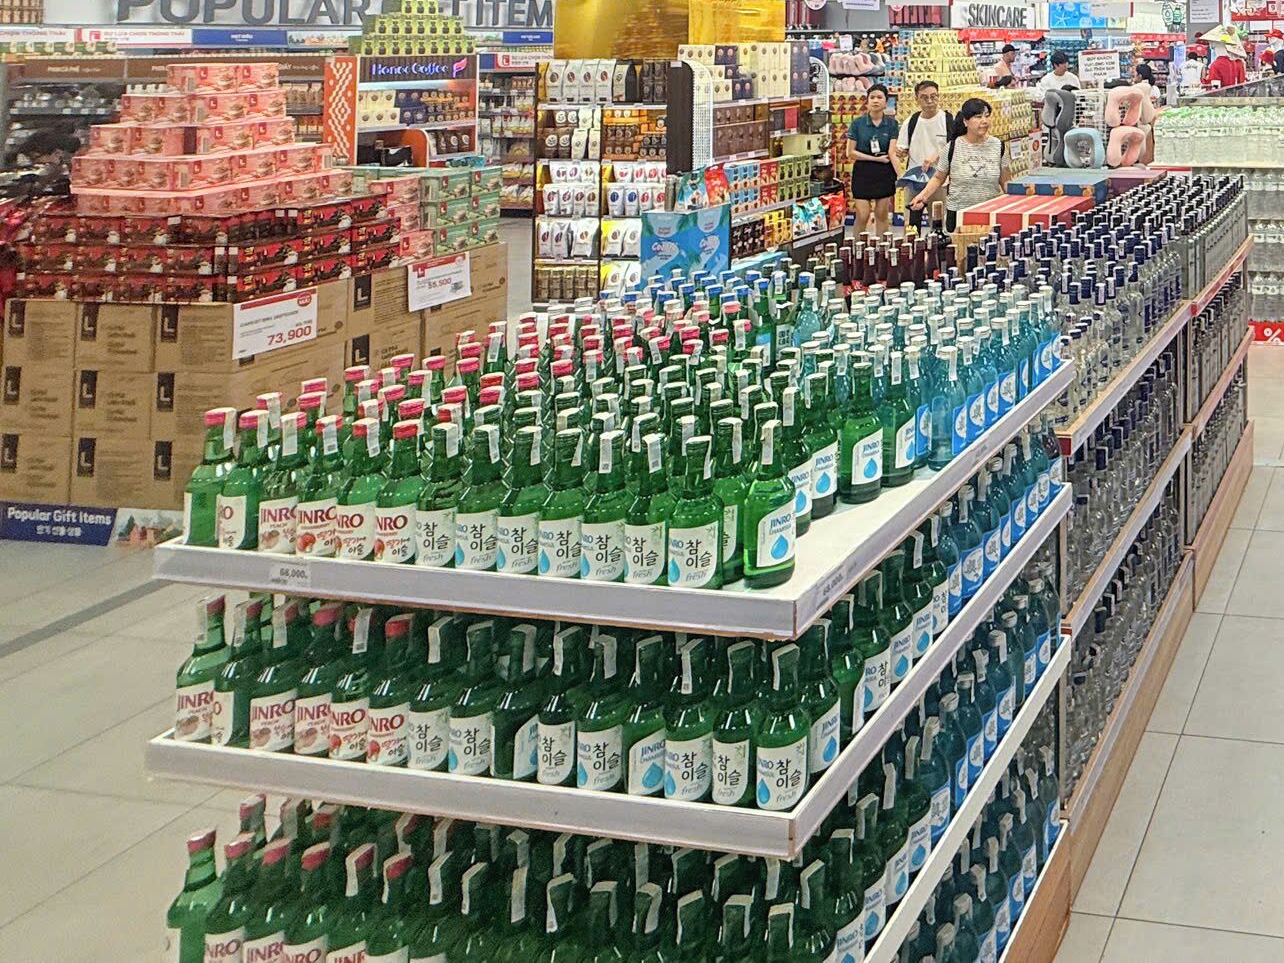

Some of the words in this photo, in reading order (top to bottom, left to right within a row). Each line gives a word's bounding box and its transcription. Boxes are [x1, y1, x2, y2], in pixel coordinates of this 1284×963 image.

[968, 2, 1027, 28] SKINCARE
[267, 325, 312, 345] 73,900
[7, 506, 51, 522] Popular
[53, 509, 77, 523] Gift
[79, 511, 112, 525] Items
[770, 512, 791, 527] JINRO
[423, 521, 438, 536] 참
[511, 526, 527, 542] 참
[423, 536, 451, 551] 이슬
[511, 538, 538, 556] 이슬
[595, 534, 612, 549] 참
[632, 537, 647, 552] 참
[686, 539, 703, 555] 참
[595, 546, 623, 563] 이슬
[632, 551, 659, 566] 이슬
[687, 552, 712, 568] 이슬
[252, 698, 296, 721] JINRO
[542, 736, 555, 752] 참
[593, 741, 609, 758] 참
[542, 750, 567, 767] 이슬
[593, 753, 622, 771] 이슬
[776, 758, 792, 775] 참
[776, 770, 801, 788] 이슬
